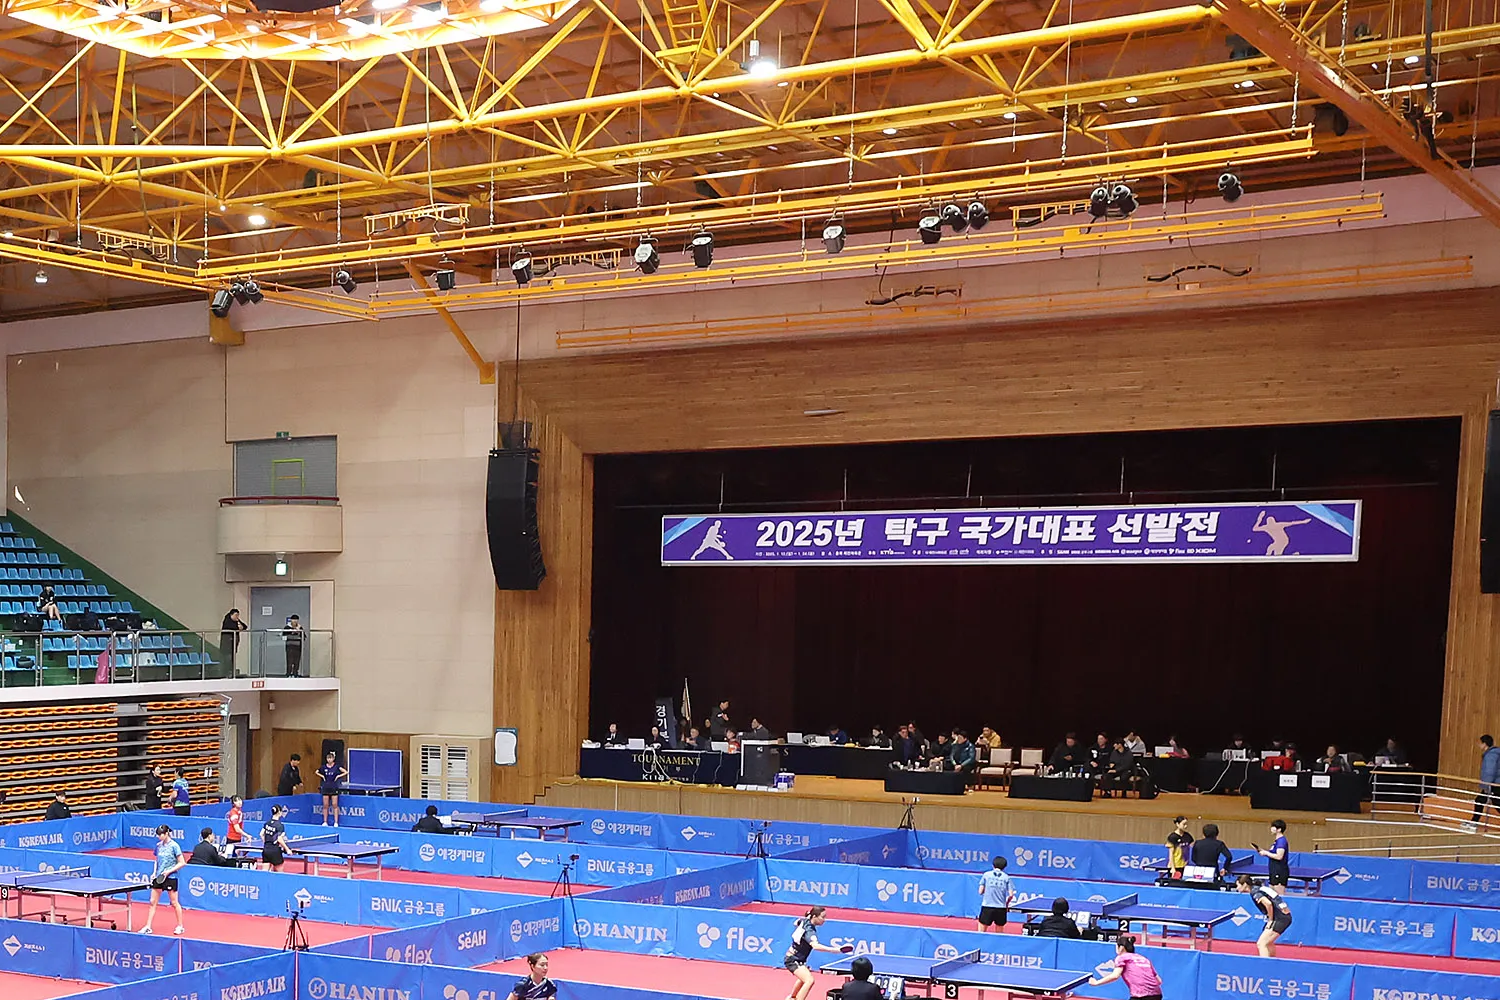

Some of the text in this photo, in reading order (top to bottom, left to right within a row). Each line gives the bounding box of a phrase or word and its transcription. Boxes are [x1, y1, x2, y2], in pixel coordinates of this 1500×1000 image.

[756, 511, 1220, 546] 2025년 탁구 국가대표 선발전
[82, 829, 118, 843] HANJIN
[130, 826, 156, 838] KORE
[607, 823, 652, 836] 애경케미칼
[19, 833, 64, 847] KOREAN AIR
[776, 833, 810, 847] 금융그룹
[437, 848, 485, 863] 애경케미칼
[932, 848, 989, 864] HANJIN
[1038, 849, 1077, 870] flex
[588, 859, 654, 877] BNK 금융그룹
[2, 887, 8, 899] 9
[208, 881, 260, 900] 애경케미칼
[784, 878, 850, 898] HANJIN
[1427, 876, 1464, 891] BNK
[902, 882, 945, 906] flex
[372, 898, 445, 917] BNK 금융그룹
[523, 916, 560, 936] 애경케미칼
[593, 923, 668, 945] HANJIN
[1119, 920, 1128, 931] 2
[1334, 916, 1435, 938] BNK 금융그룹
[726, 927, 773, 953] flex
[86, 947, 165, 972] BNK 금융그룹
[404, 945, 433, 964] flex
[266, 975, 286, 996] AIR
[947, 984, 957, 997] 3
[1216, 974, 1332, 1000] BNK 금융그룹
